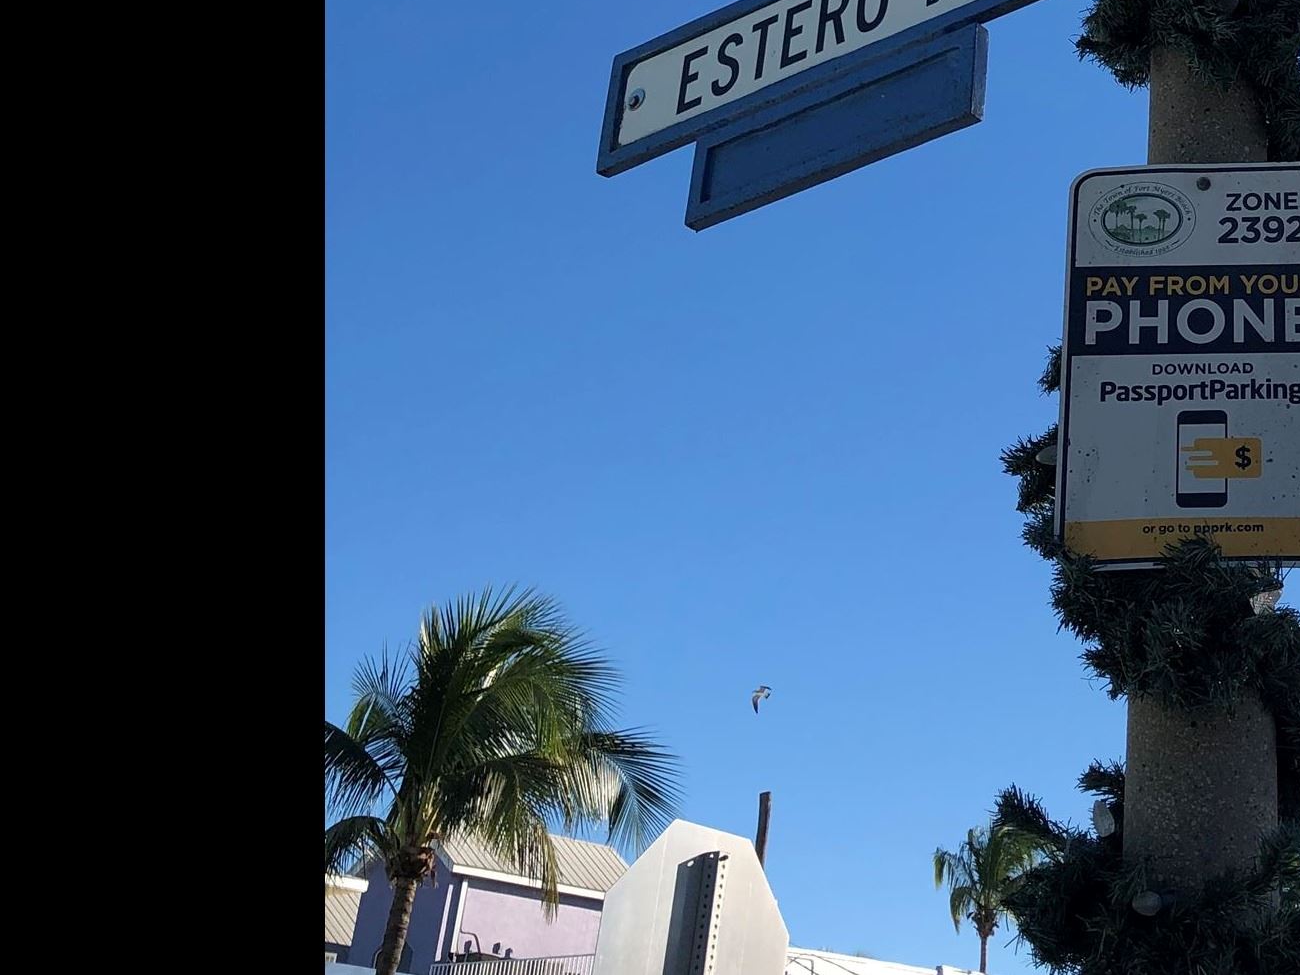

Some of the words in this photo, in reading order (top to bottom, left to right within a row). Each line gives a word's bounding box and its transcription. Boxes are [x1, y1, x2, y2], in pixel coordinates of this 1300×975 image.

[1226, 192, 1299, 211] ZONE
[1086, 276, 1139, 297] PAY
[1149, 275, 1229, 296] FROM
[1151, 362, 1254, 376] DOWNLOAD
[1143, 525, 1155, 534] or
[1158, 524, 1175, 534] go
[1178, 523, 1190, 533] to
